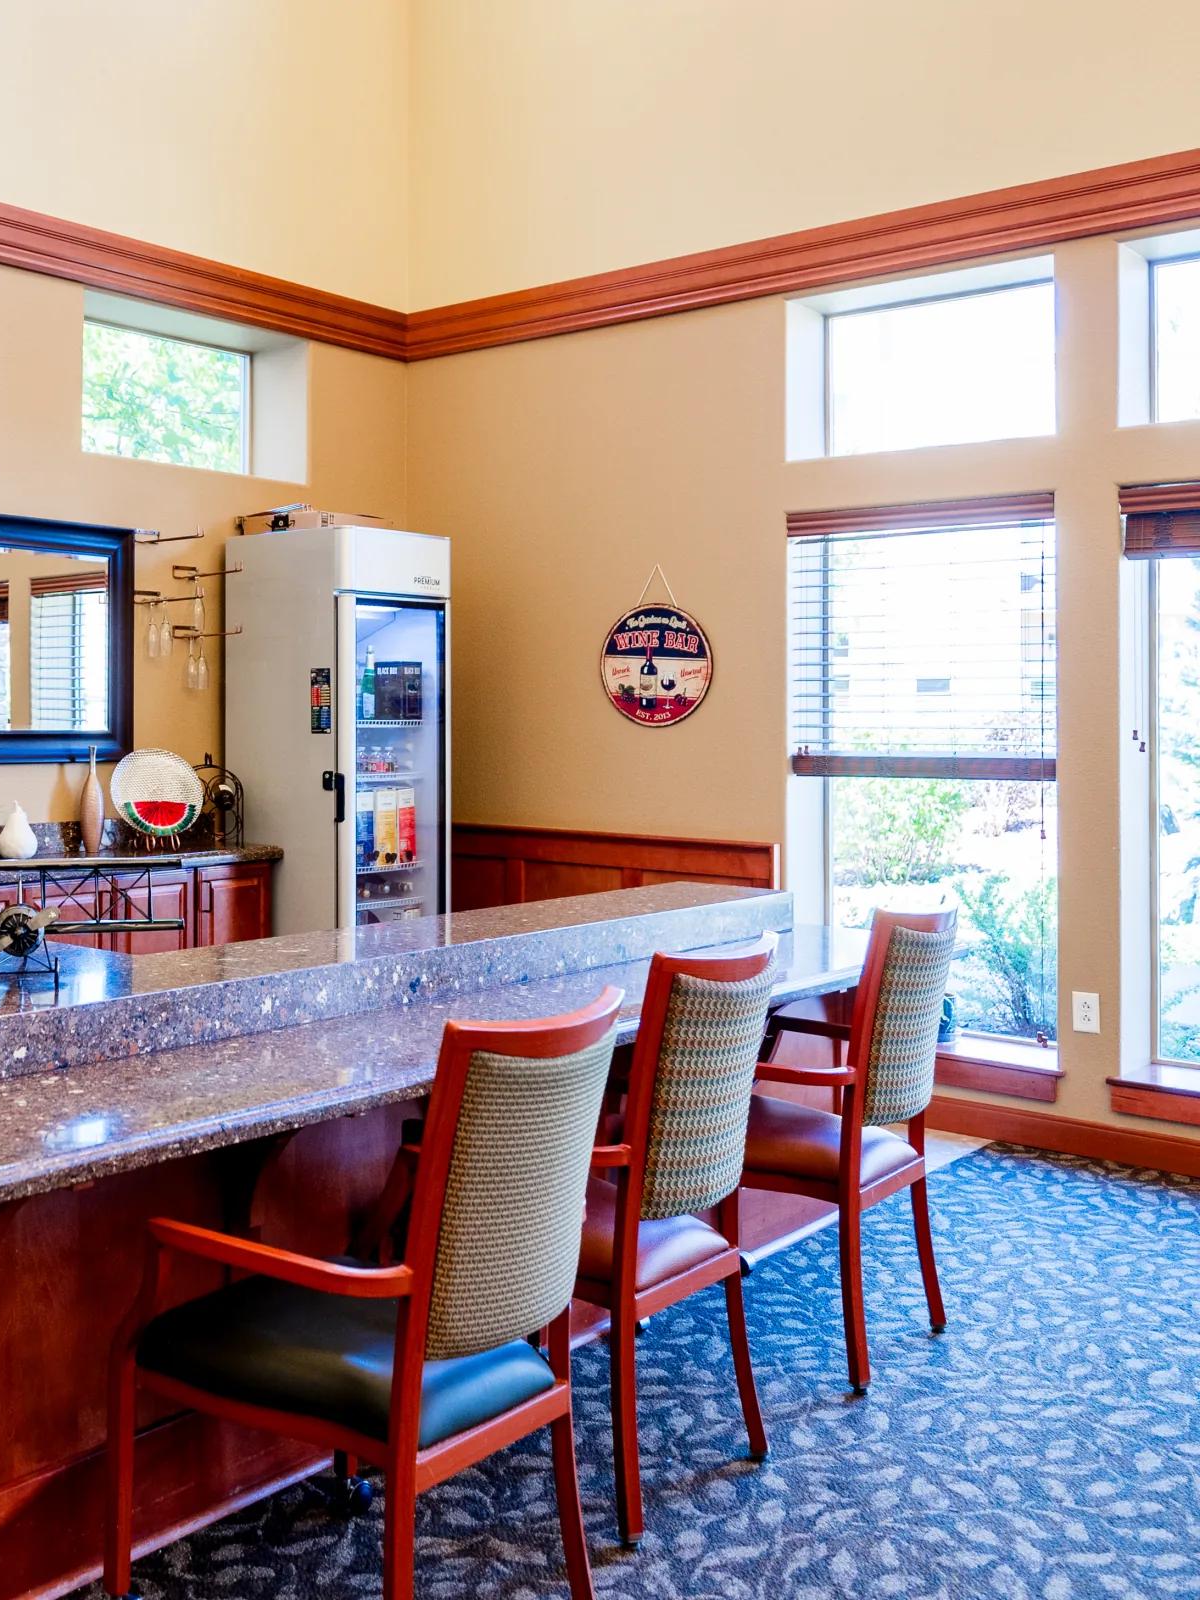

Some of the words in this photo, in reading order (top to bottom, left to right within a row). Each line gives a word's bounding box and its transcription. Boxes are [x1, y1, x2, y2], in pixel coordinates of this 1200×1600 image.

[413, 576, 441, 586] PREMIUM
[615, 630, 659, 649] WINE
[665, 631, 699, 653] BAR
